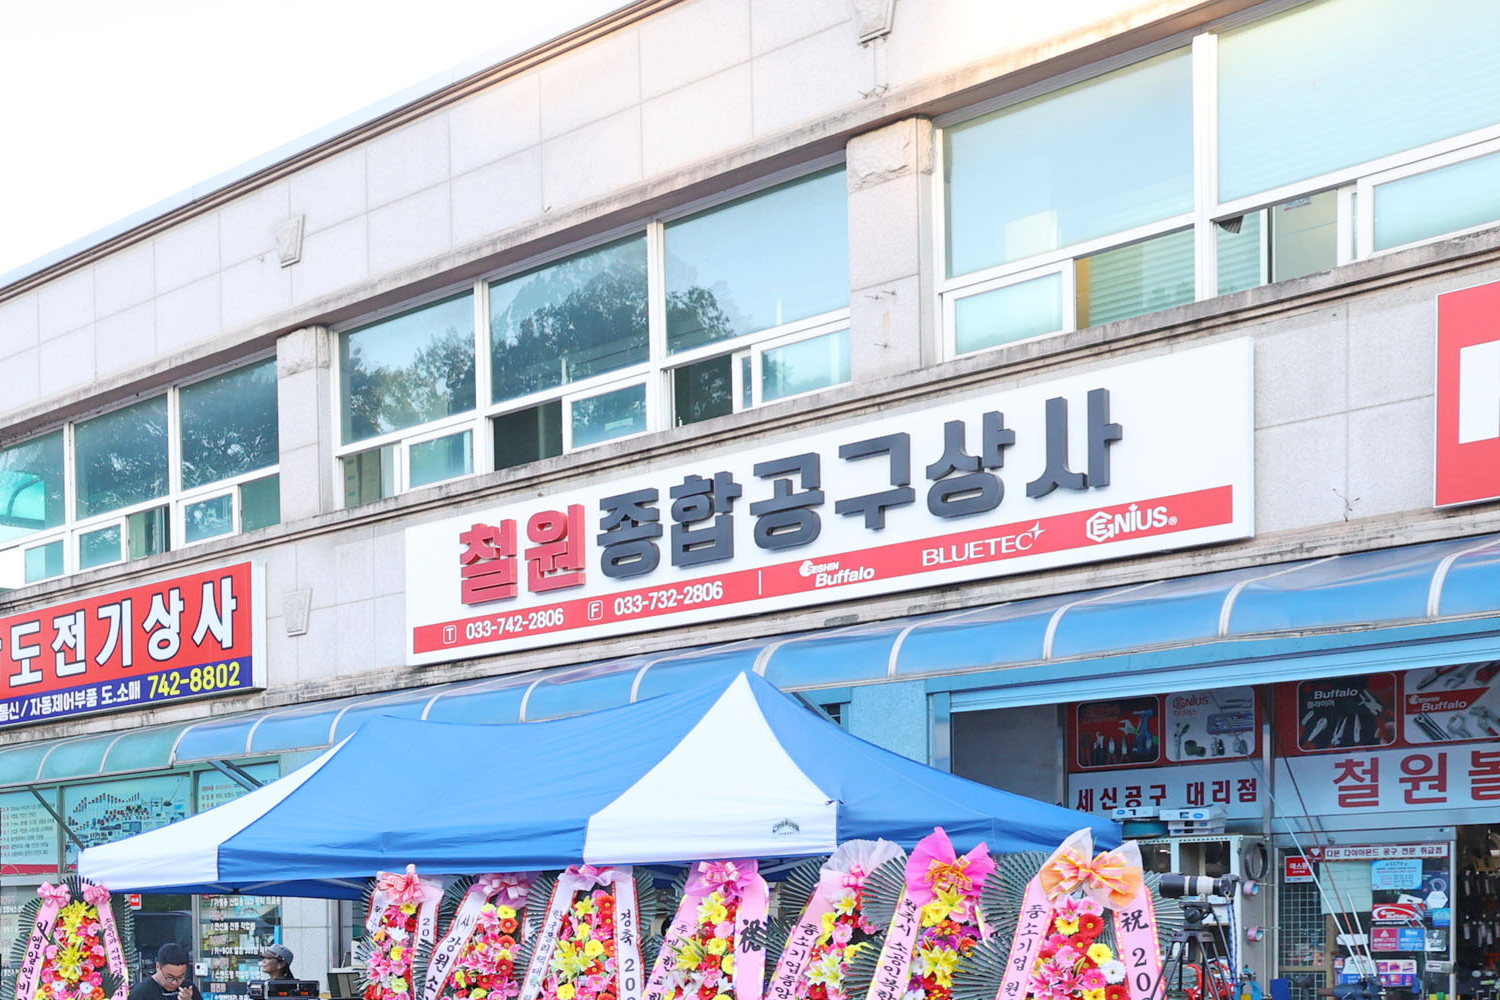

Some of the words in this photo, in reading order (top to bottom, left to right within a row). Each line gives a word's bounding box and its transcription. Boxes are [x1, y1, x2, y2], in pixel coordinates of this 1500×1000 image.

[922, 532, 1036, 567] BLUETEC
[815, 565, 876, 588] Buffalo
[466, 609, 564, 640] 033-742-2806
[614, 581, 723, 615] 033-732-2806
[147, 661, 240, 699] 742-8802
[1314, 688, 1359, 700] Buffalo
[1421, 700, 1467, 712] Buffalo
[1077, 784, 1167, 812] 세신공구
[1187, 778, 1257, 806] 대리점
[620, 909, 634, 947] 경축
[1121, 909, 1149, 933] 祝
